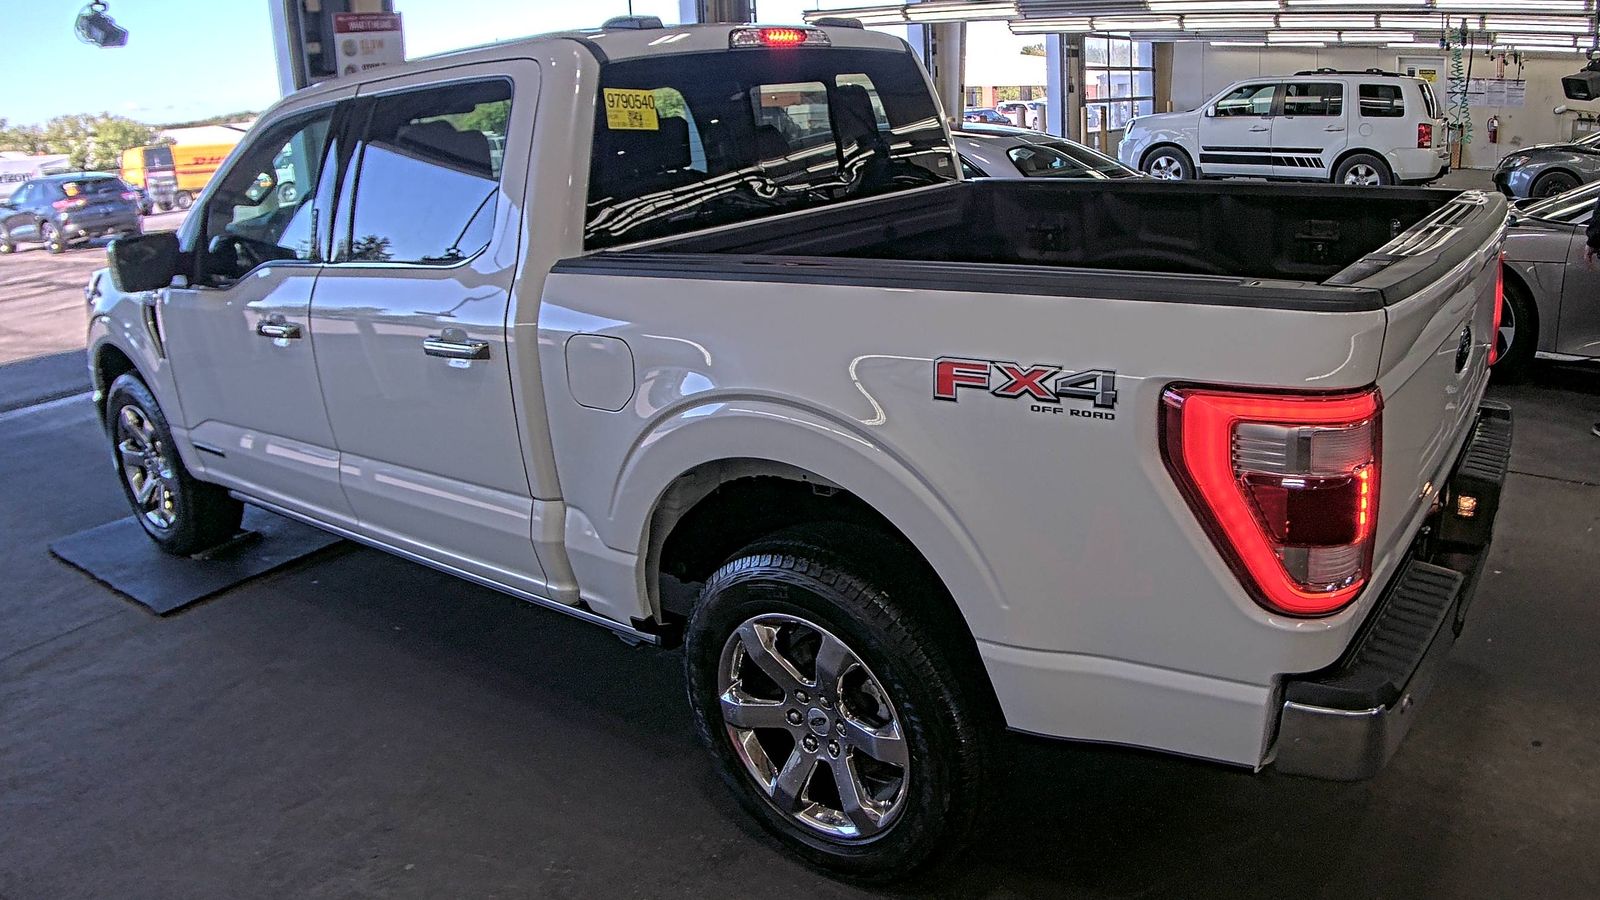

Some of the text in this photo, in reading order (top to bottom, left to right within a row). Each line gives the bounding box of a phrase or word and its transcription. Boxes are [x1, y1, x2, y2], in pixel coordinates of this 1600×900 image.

[607, 93, 655, 110] 9790540
[933, 356, 1118, 410] FX4
[1030, 405, 1115, 421] OFF ROAD
